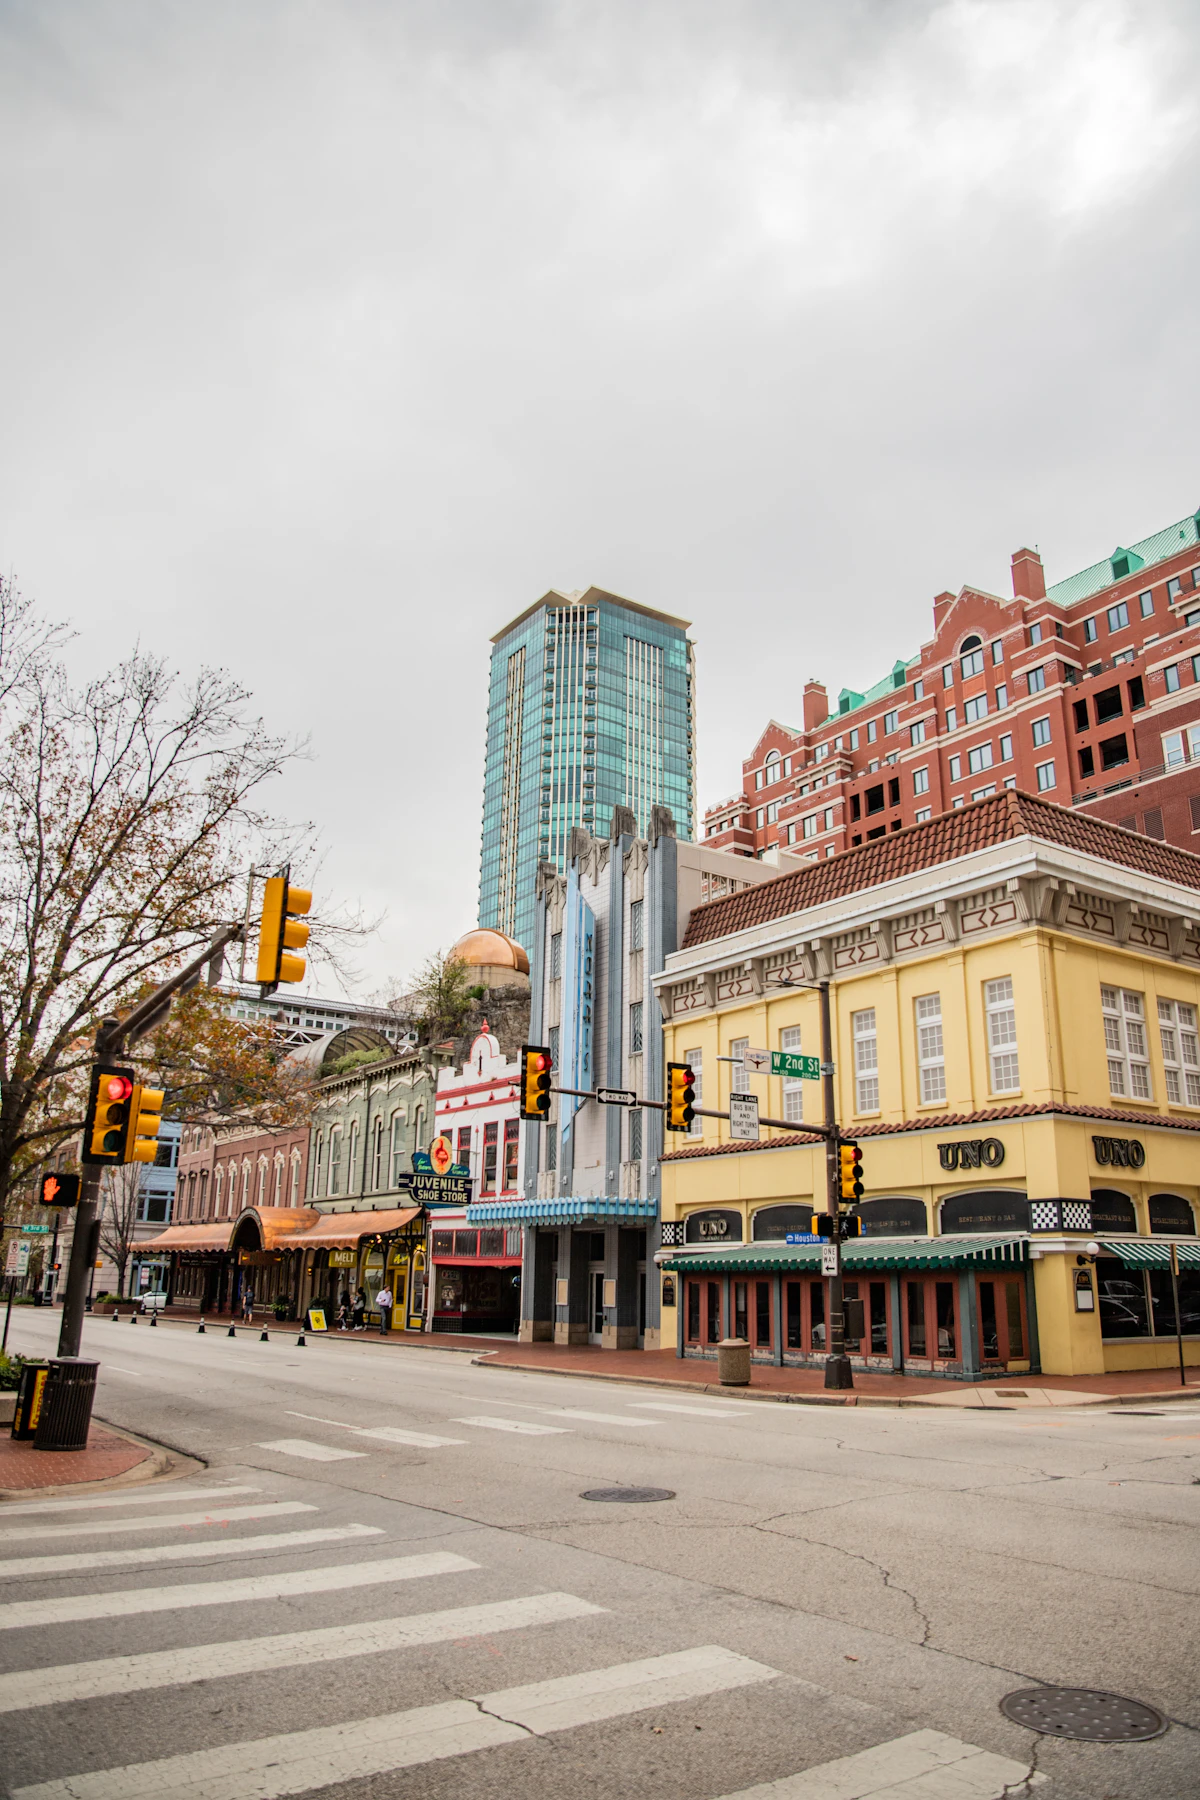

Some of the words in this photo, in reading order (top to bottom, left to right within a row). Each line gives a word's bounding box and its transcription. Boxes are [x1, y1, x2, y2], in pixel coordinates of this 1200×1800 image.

[773, 1053, 781, 1067] W
[785, 1055, 804, 1070] 2nd
[808, 1058, 818, 1072] St
[938, 1138, 1005, 1171] UNO
[1092, 1136, 1145, 1168] UNO
[408, 1176, 465, 1191] JUVENILE
[418, 1189, 439, 1200] SHOE
[442, 1192, 468, 1202] STORE
[699, 1219, 727, 1236] UNO
[795, 1233, 820, 1243] Houston
[335, 1252, 355, 1263] MELT
